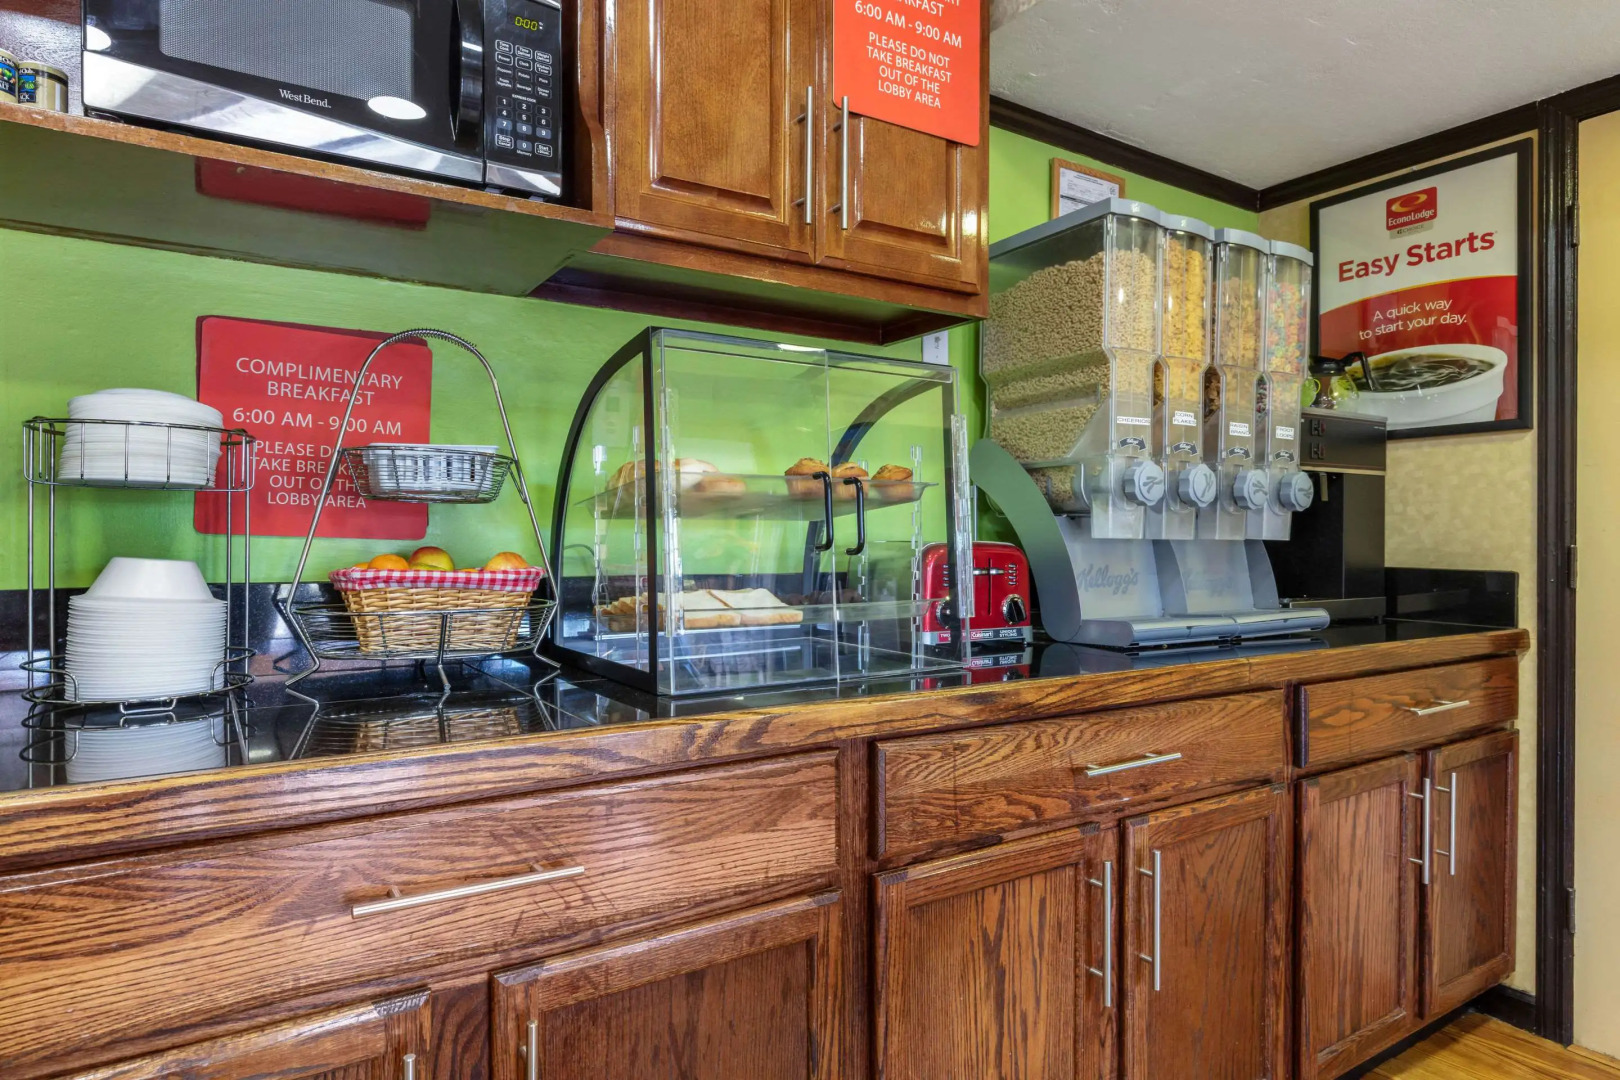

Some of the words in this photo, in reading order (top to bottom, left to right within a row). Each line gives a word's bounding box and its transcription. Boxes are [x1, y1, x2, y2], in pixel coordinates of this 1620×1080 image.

[515, 17, 537, 30] 0:00
[855, 0, 882, 20] 6:00
[885, 10, 906, 29] AM
[915, 21, 940, 41] 9:00
[943, 31, 962, 49] AM
[868, 31, 907, 55] PLEASE
[910, 45, 926, 61] DO
[929, 52, 950, 68] NOT
[866, 45, 893, 65] TAKE
[896, 55, 952, 83] BREAKFAST
[879, 65, 902, 82] OUT
[904, 73, 919, 86] OF
[921, 78, 941, 94] THE
[279, 89, 302, 103] West
[303, 94, 328, 108] Bend
[878, 79, 912, 99] LOBBY
[914, 91, 941, 109] AREA
[1338, 253, 1400, 283] Easy
[1406, 231, 1496, 267] Starts
[1372, 310, 1384, 322] A
[1386, 302, 1421, 319] quick
[1425, 299, 1453, 311] way
[1359, 330, 1372, 340] to
[1375, 320, 1404, 336] start
[1407, 316, 1438, 331] your
[1440, 312, 1467, 326] day.
[236, 357, 403, 390] COMPLIMENTARY
[267, 380, 375, 406] BREAKFAST
[233, 407, 275, 425] 6:00
[281, 411, 313, 428] AM
[372, 420, 402, 436] AM
[1117, 417, 1151, 425] CHEERIOS
[255, 440, 315, 457] PLEASE
[320, 445, 338, 458] D
[269, 474, 306, 489] OUT
[268, 491, 322, 506] LOBBY
[325, 495, 367, 509] AREA
[1077, 563, 1140, 596] Kellogg's
